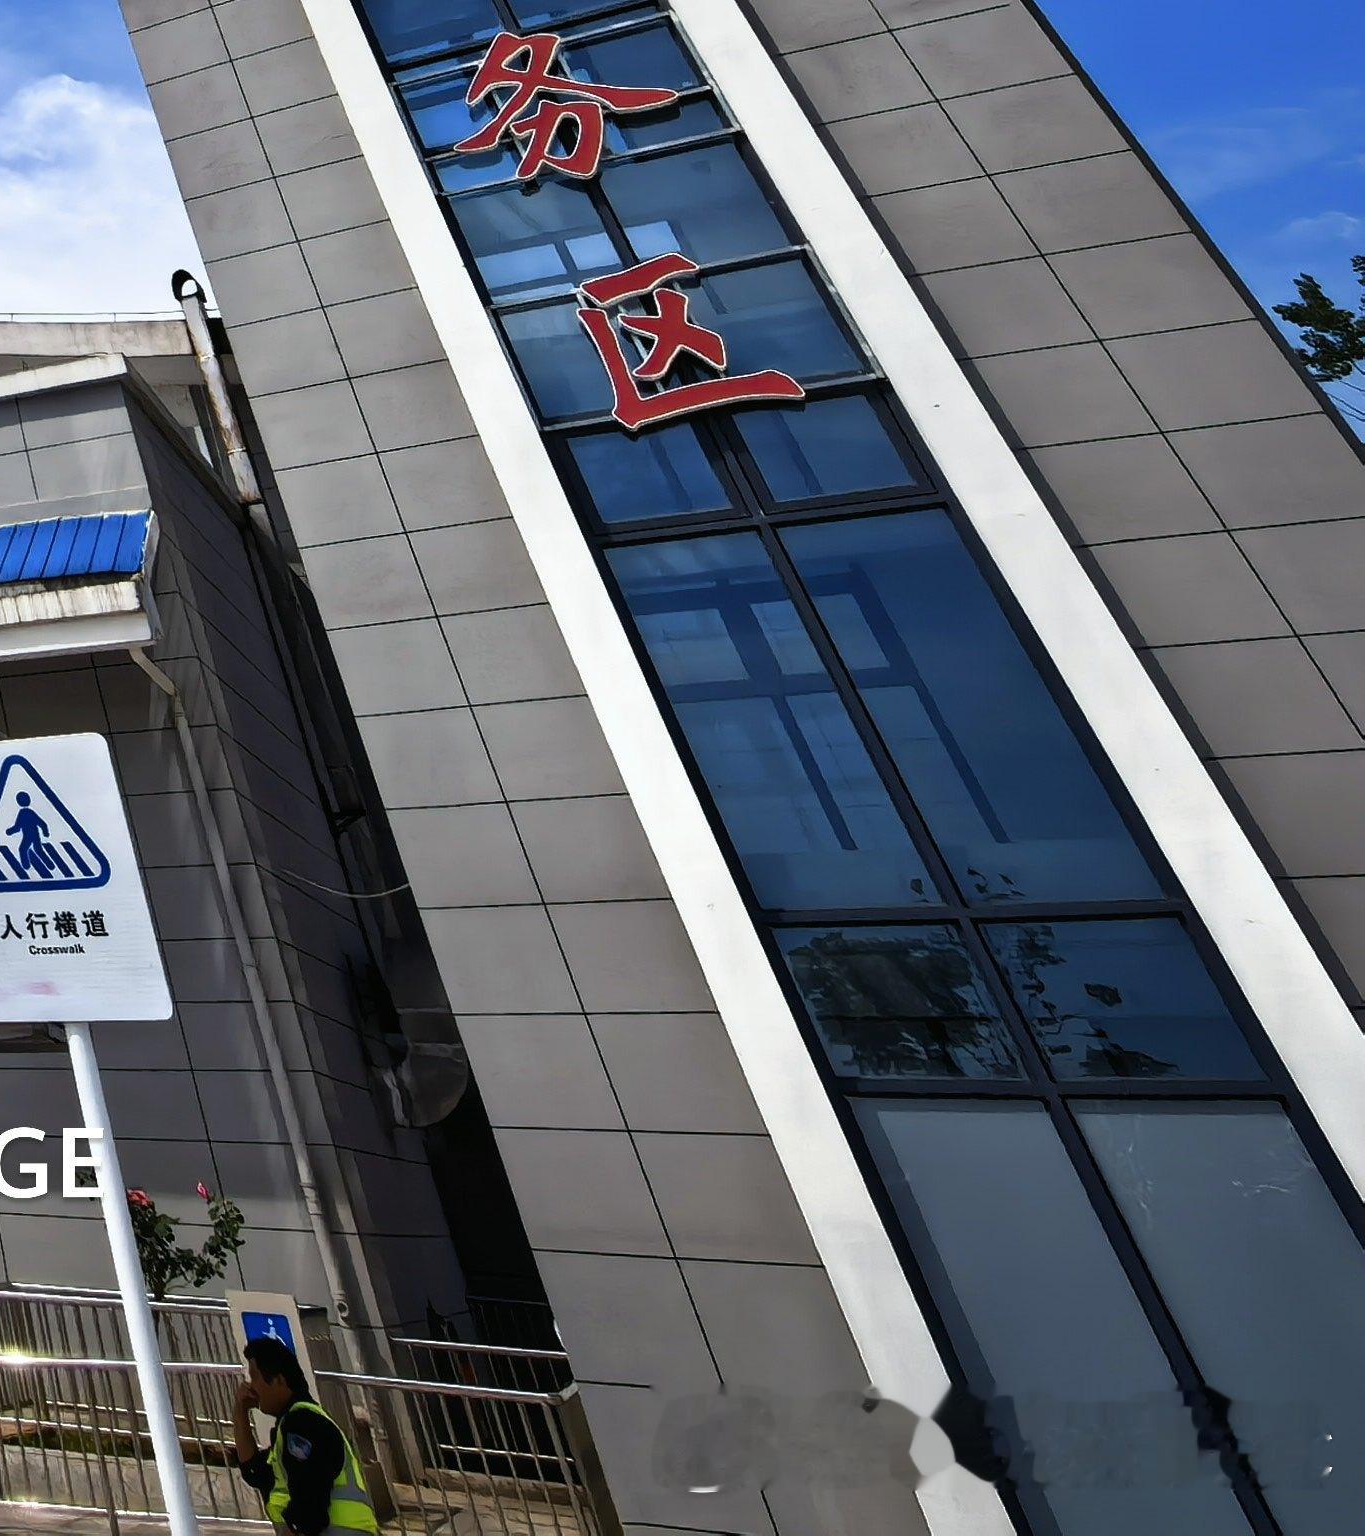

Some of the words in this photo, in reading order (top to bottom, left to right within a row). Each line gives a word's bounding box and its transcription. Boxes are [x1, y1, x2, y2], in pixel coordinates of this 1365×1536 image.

[0, 910, 109, 939] 人行横道
[28, 944, 85, 955] Crosswalk
